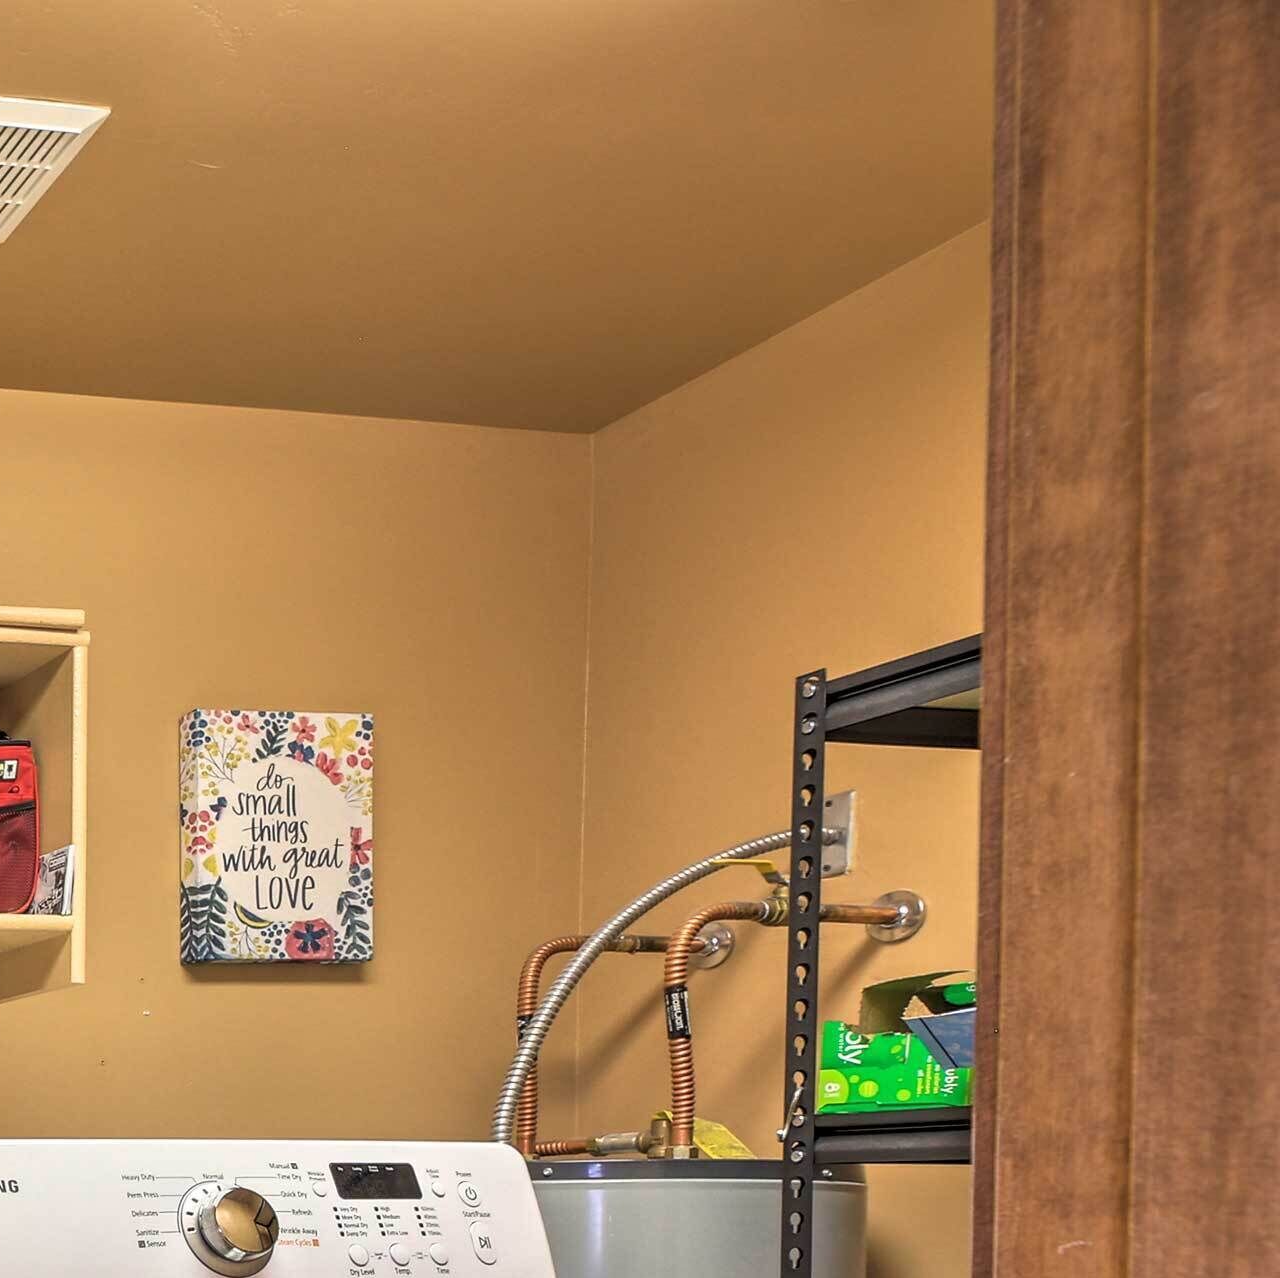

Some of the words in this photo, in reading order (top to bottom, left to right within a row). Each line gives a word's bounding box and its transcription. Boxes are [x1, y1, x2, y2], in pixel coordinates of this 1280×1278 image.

[257, 763, 294, 791] do
[232, 785, 296, 816] small
[242, 818, 309, 844] things
[222, 845, 276, 872] with
[282, 838, 344, 879] great
[146, 1240, 167, 1248] Sensor
